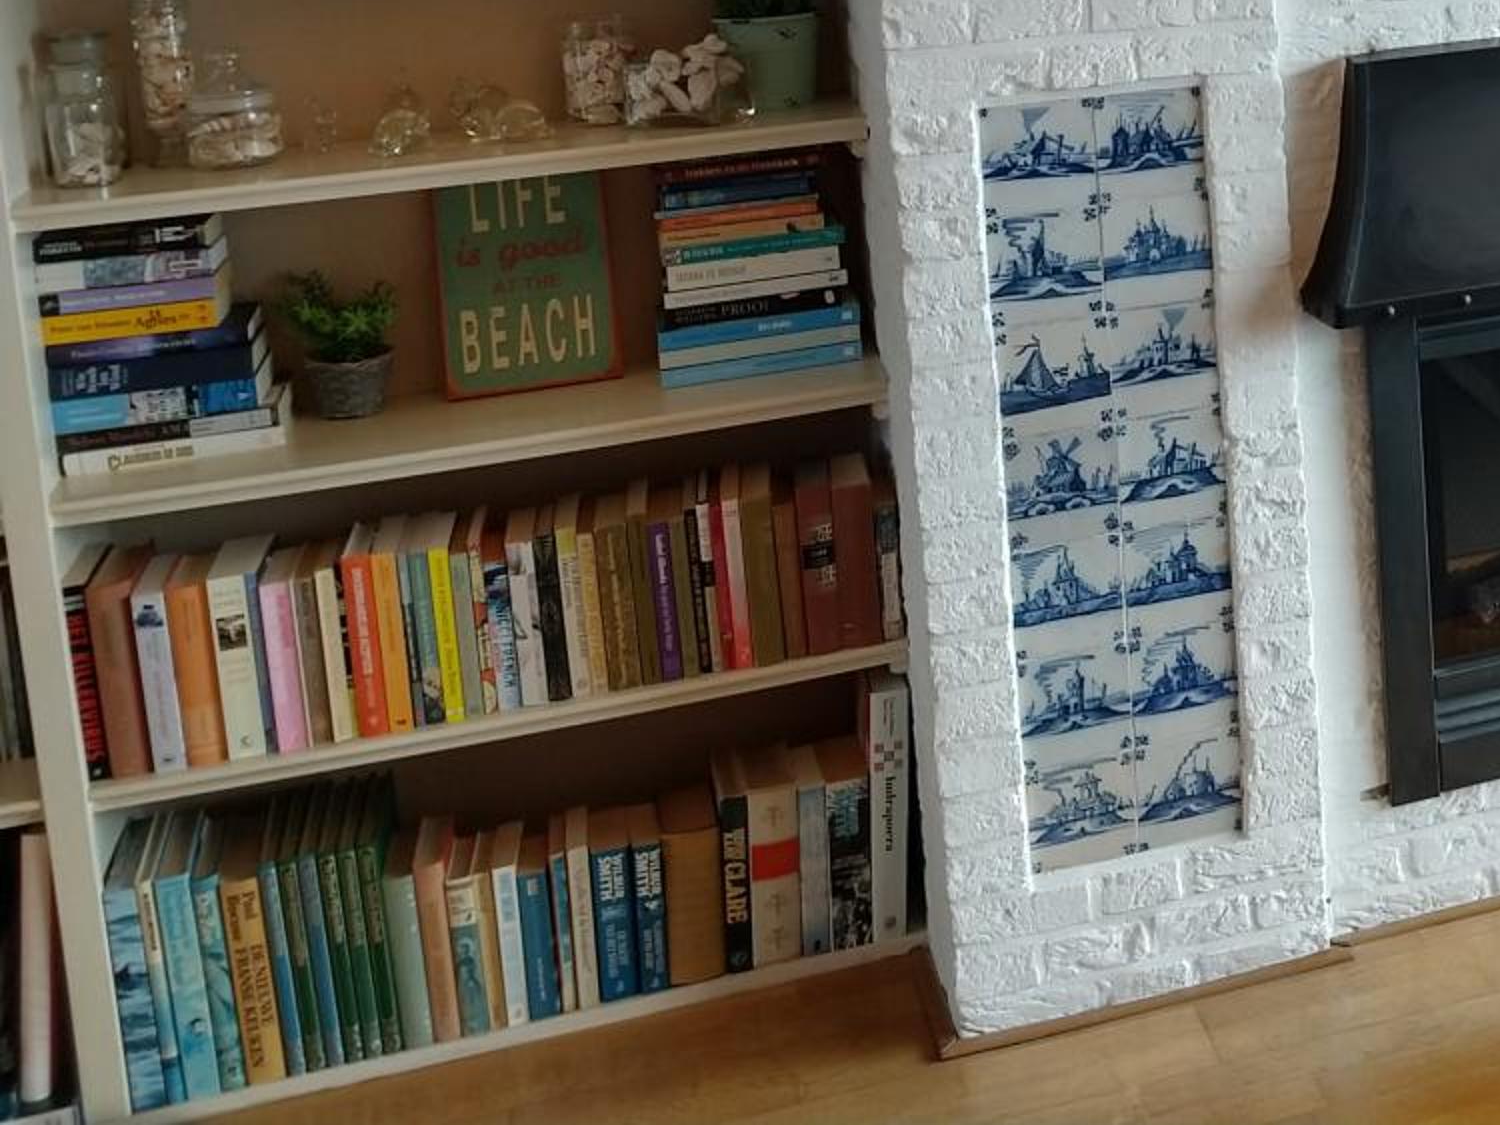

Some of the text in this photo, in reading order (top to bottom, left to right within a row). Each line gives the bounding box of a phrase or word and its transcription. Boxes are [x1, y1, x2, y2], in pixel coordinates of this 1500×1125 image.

[470, 174, 566, 233] LIFE
[459, 293, 596, 375] BEACH
[71, 653, 106, 762] KILLERVIRUS
[597, 856, 614, 902] SMITH
[635, 851, 651, 899] SMITH
[724, 861, 748, 924] CLARE
[234, 947, 256, 1005] FRANSE
[253, 966, 275, 1028] NIEUWE
[243, 1006, 264, 1069] KEUKEN
